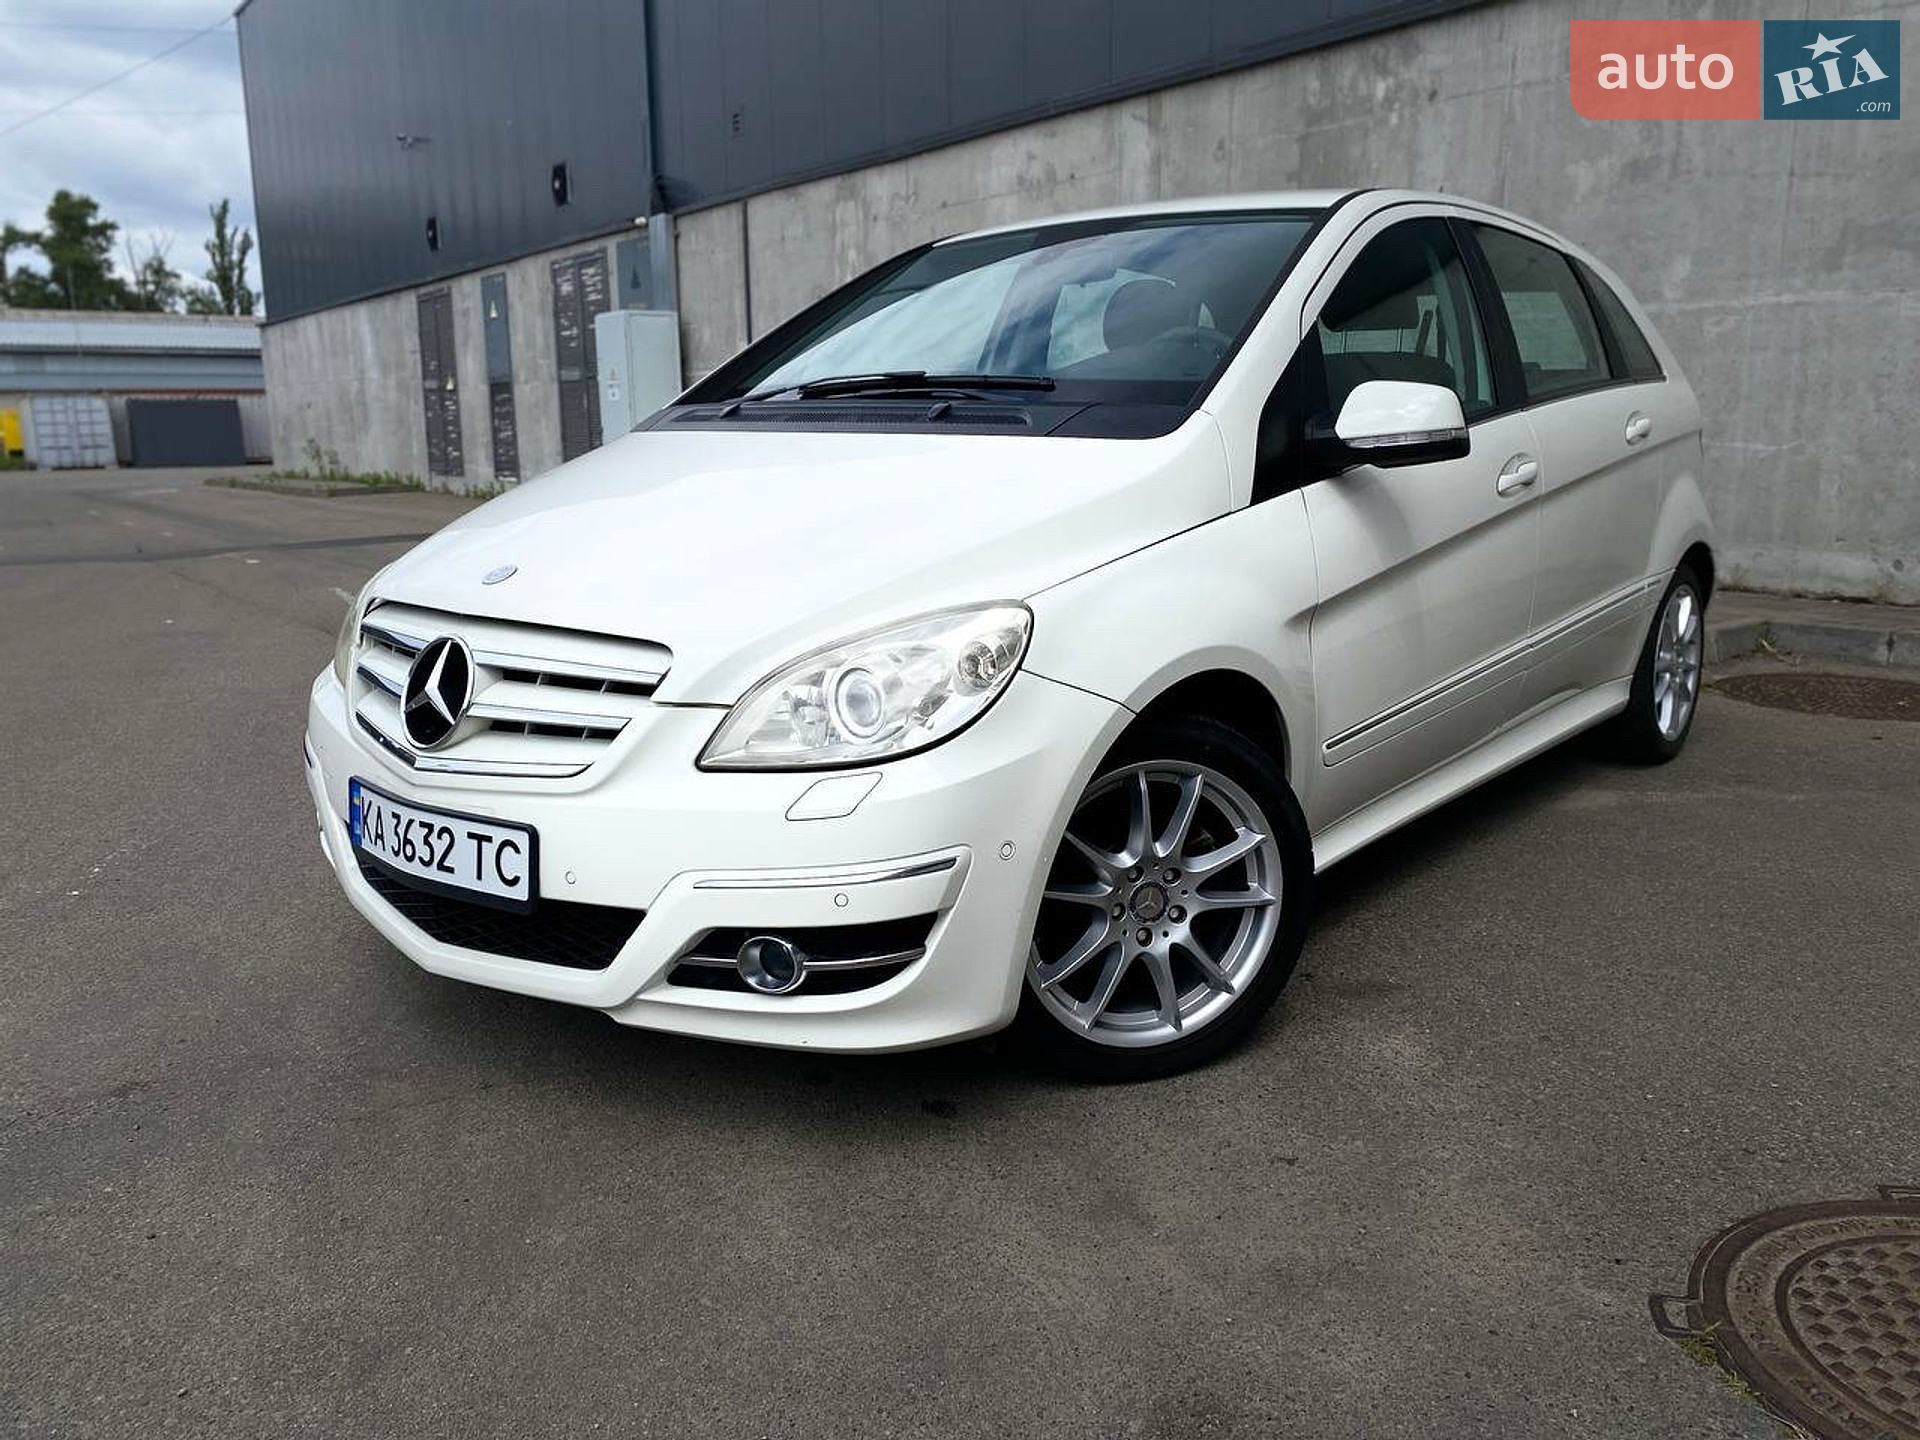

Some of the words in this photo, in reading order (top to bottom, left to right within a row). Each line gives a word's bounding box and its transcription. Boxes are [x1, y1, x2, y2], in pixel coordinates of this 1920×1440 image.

[361, 796, 386, 851] KA
[391, 811, 455, 875] 3632
[466, 831, 521, 888] TC
